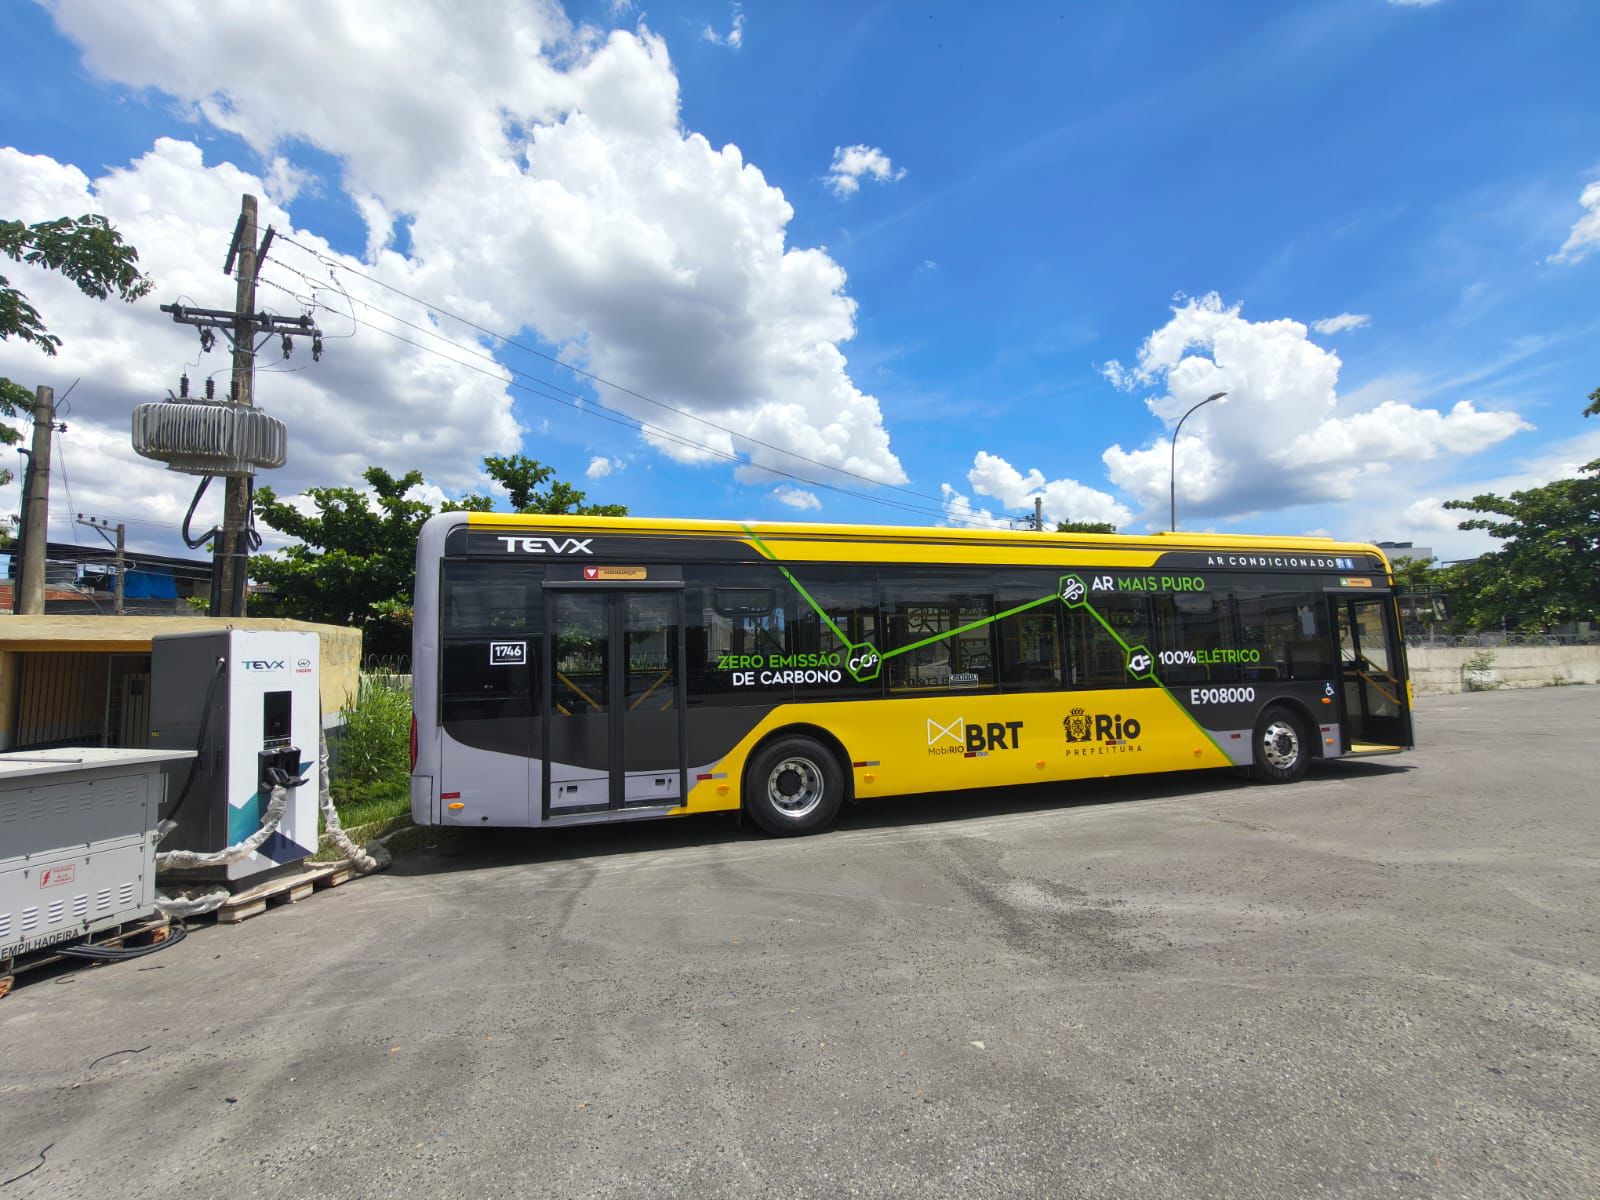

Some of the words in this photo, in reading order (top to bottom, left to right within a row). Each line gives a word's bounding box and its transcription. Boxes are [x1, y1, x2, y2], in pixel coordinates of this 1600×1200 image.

[497, 536, 594, 554] TEVX
[1207, 556, 1225, 566] AR
[1229, 556, 1335, 567] CONDICIONADO
[1091, 575, 1115, 591] AR
[1117, 576, 1158, 592] MAIS
[1161, 576, 1206, 592] PURO
[495, 645, 522, 657] 1746
[241, 660, 285, 670] TEVX
[717, 655, 764, 670] ZERO
[769, 651, 841, 669] EMISSÃO
[732, 671, 756, 687] DE
[760, 669, 842, 685] CARBONO
[1190, 687, 1256, 705] E908000
[1095, 713, 1142, 741] Rio
[965, 721, 1024, 753] BRT
[928, 745, 965, 756] MobiRIO
[1065, 745, 1143, 757] PREFEITURA
[1, 928, 80, 960] EMPILHADEIRA
